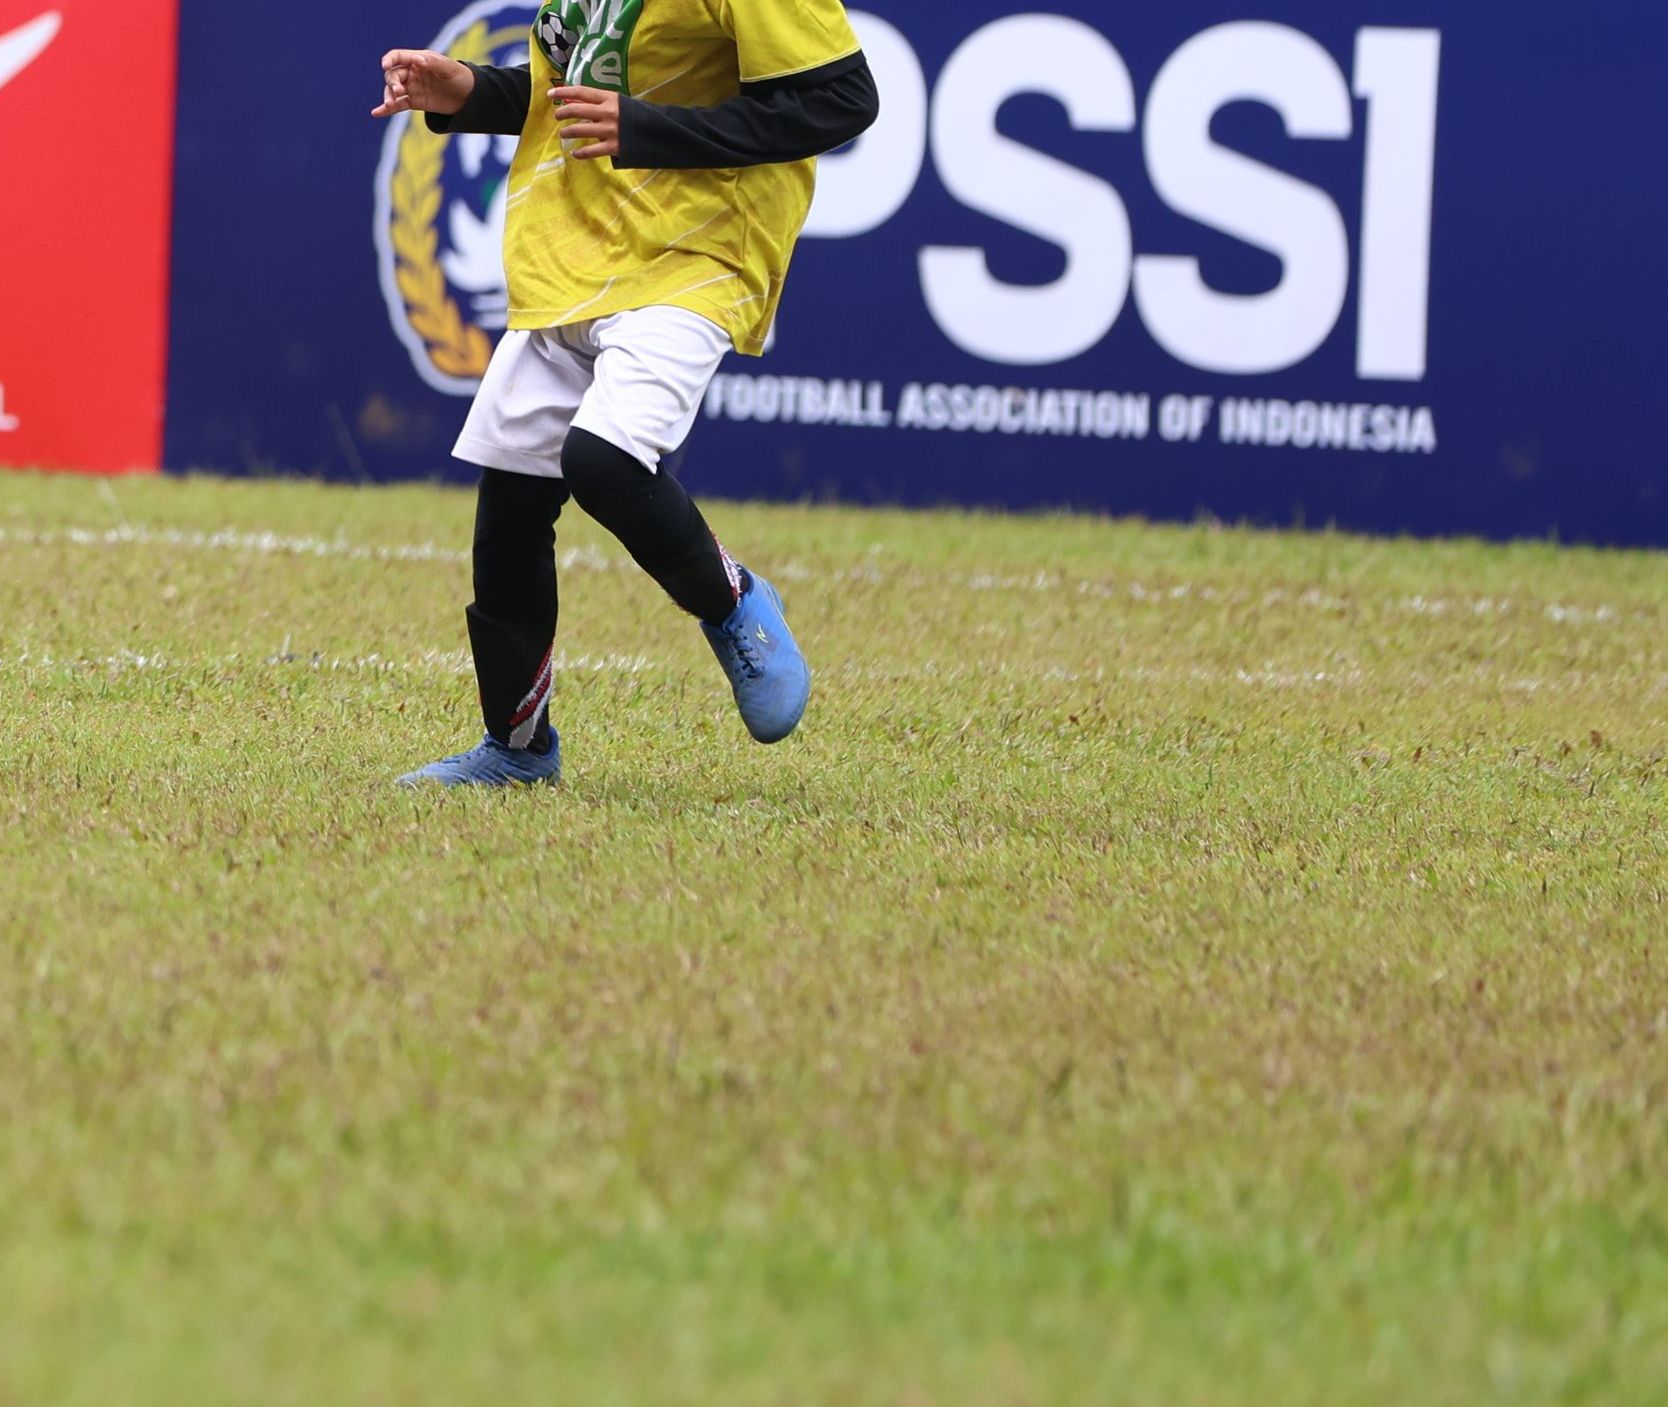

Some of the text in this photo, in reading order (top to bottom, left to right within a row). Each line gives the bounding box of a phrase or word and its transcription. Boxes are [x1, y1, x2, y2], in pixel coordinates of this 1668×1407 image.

[705, 372, 1437, 454] FOOTBALL ASSOCIATION OF INDONESIA
